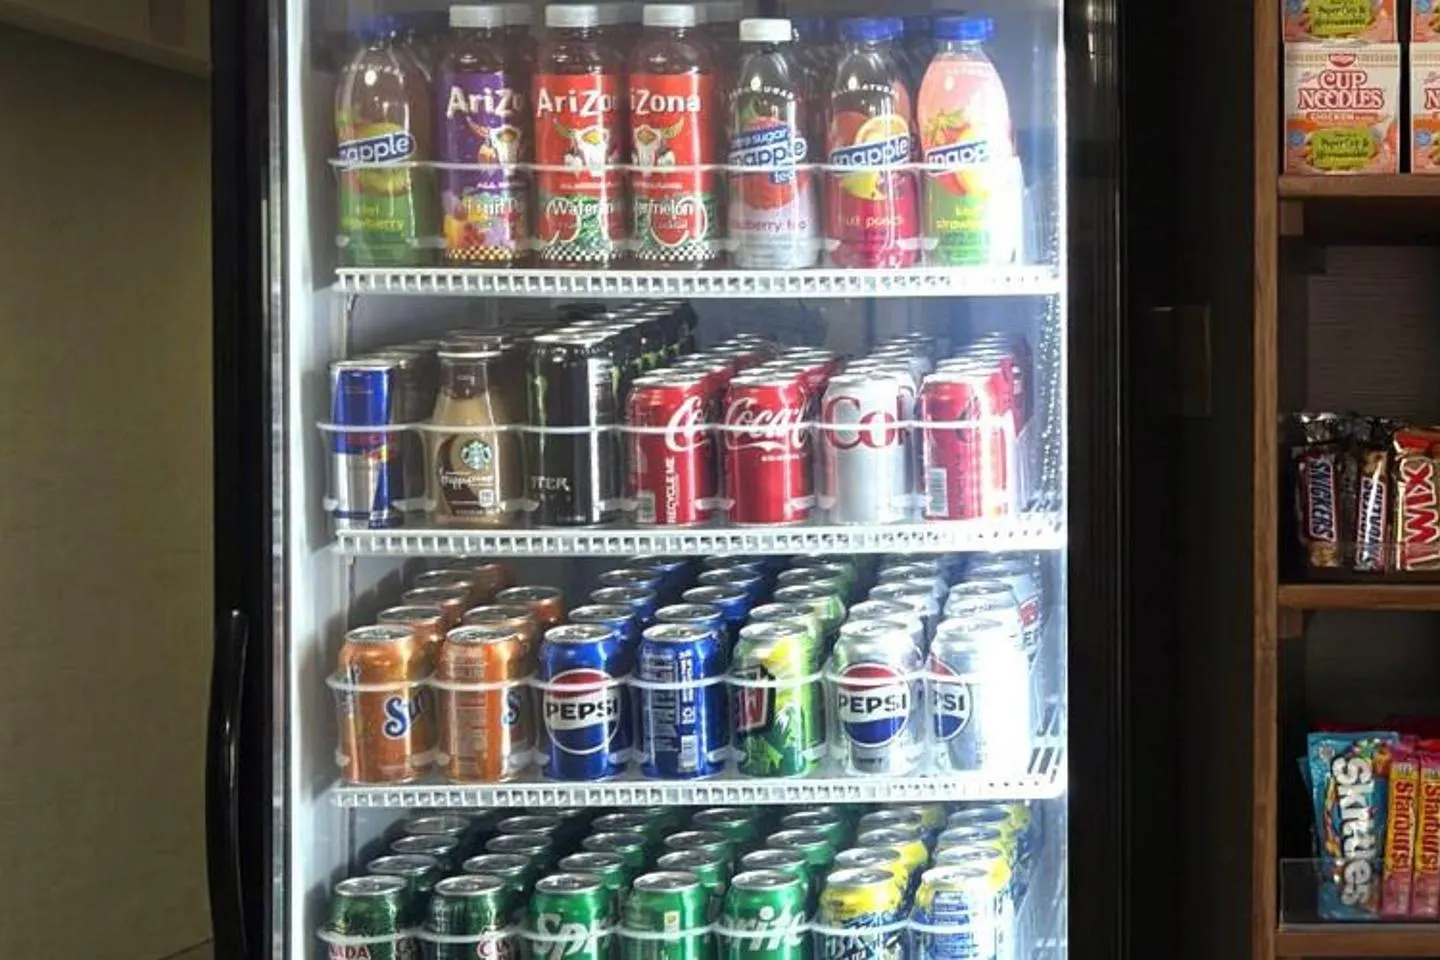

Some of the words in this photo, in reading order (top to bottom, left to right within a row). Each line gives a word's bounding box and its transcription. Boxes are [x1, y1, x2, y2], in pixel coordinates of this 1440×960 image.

[1319, 70, 1367, 90] CUP
[1297, 88, 1384, 110] NOODLES
[1310, 461, 1334, 538] SNICKERS
[546, 698, 618, 721] PEPSI
[840, 694, 907, 713] PEPSI
